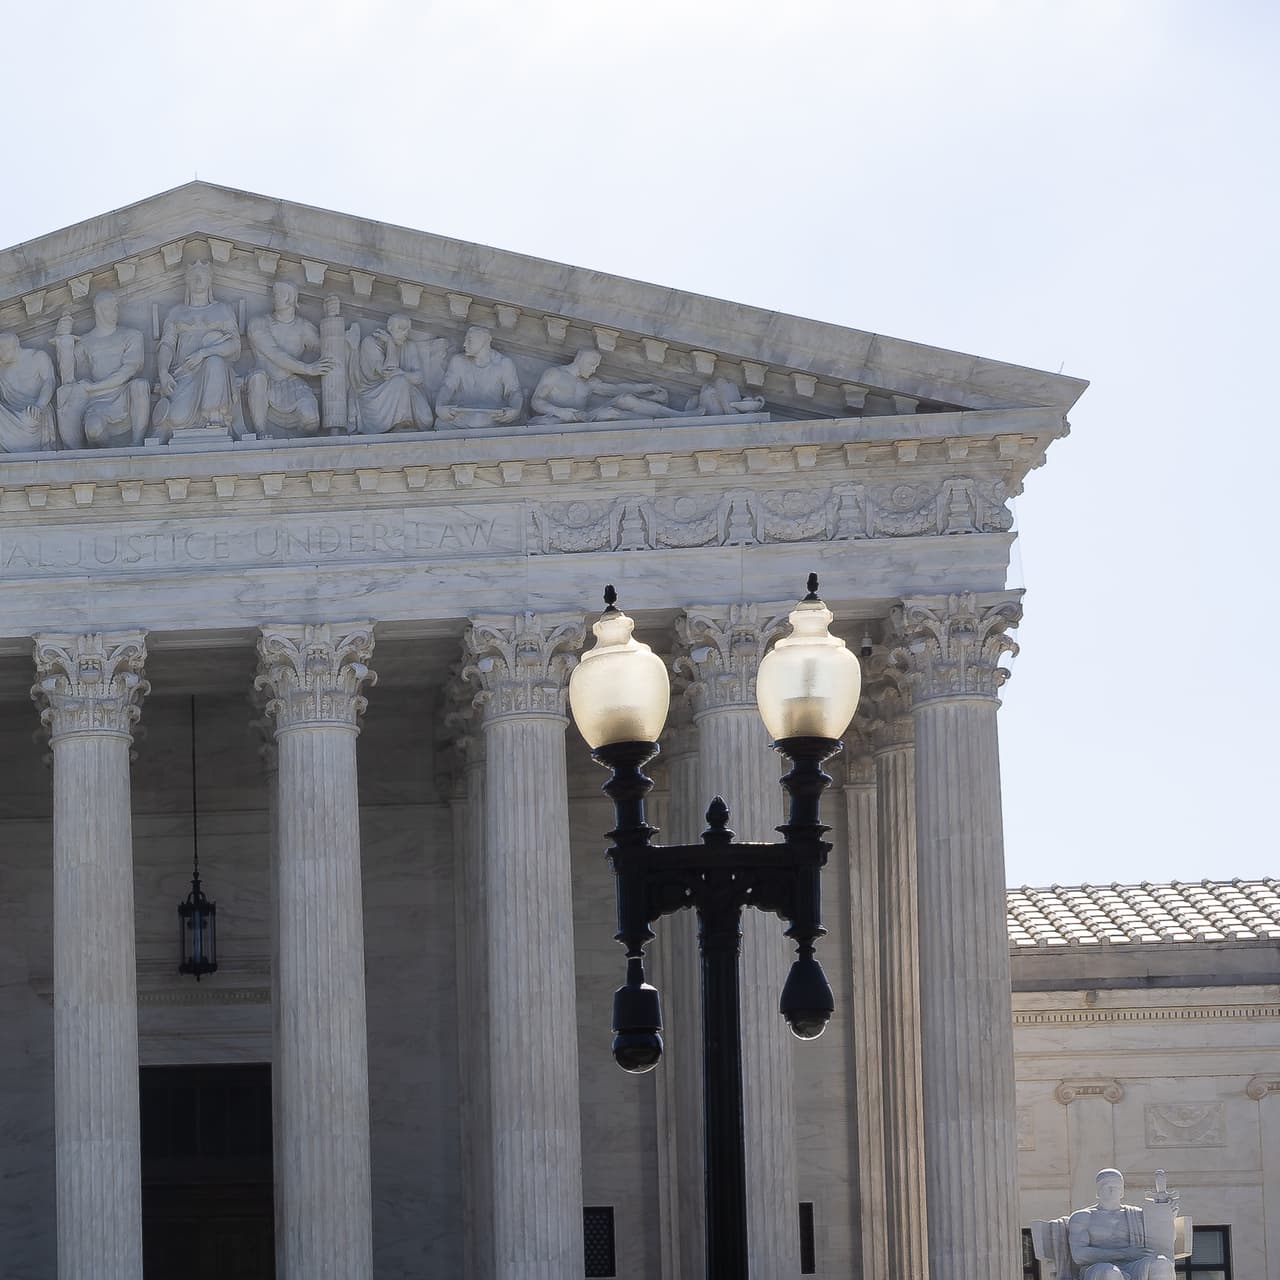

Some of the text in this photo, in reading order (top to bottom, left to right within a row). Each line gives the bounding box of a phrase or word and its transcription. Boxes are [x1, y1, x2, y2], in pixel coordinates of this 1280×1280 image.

[64, 530, 232, 568] JUSTICE
[254, 522, 387, 559] UNDER
[415, 516, 497, 551] LAW
